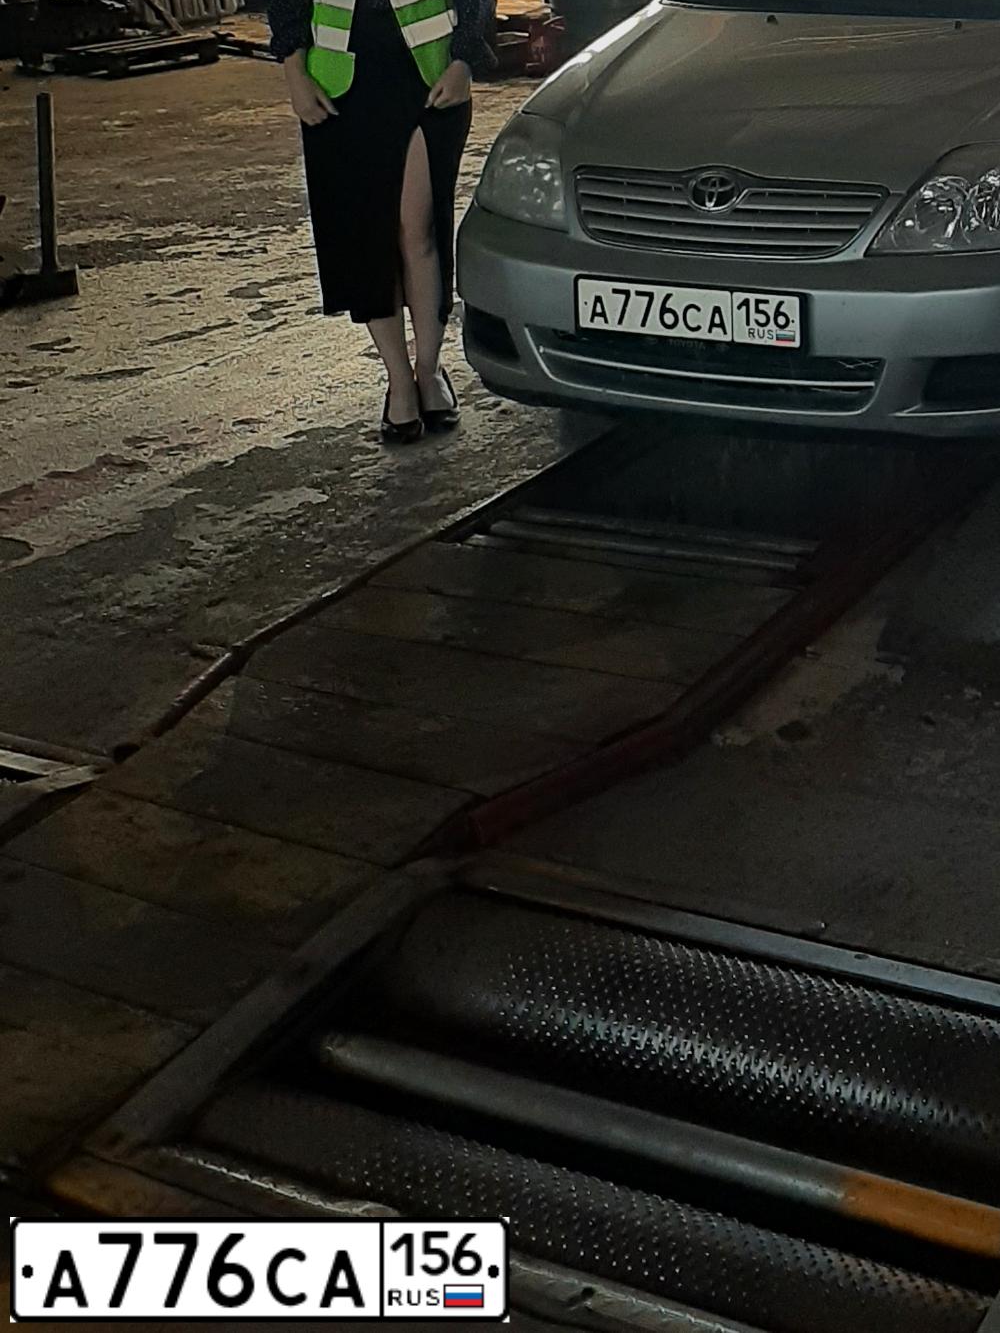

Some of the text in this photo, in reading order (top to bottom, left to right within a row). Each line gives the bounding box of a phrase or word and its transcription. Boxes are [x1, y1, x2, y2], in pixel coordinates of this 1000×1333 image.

[589, 288, 791, 335] А776СА 156
[748, 328, 774, 340] RUS
